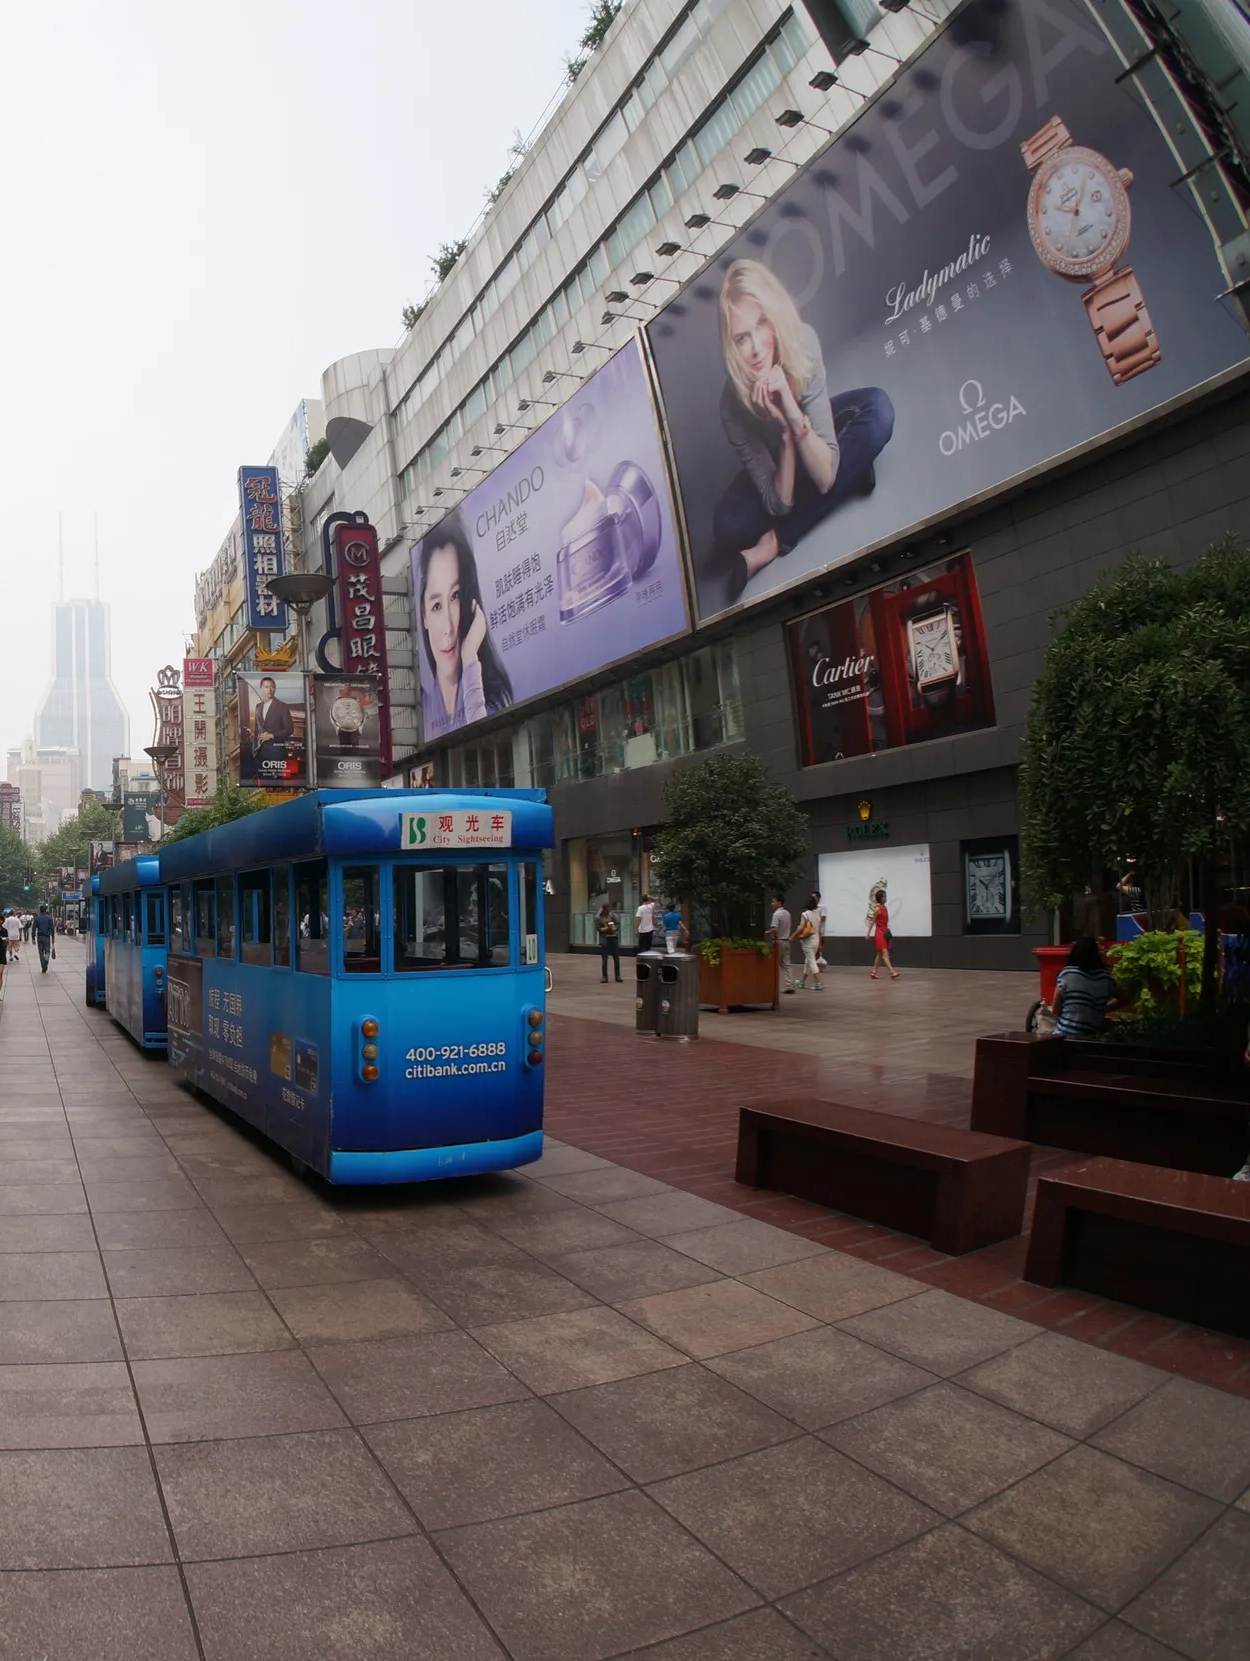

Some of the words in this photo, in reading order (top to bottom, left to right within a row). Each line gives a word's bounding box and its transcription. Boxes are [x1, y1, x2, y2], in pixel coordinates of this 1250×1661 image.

[762, 0, 1108, 310] OMEGA
[885, 233, 990, 325] Ladymatic
[939, 394, 1027, 456] OMEGA
[475, 465, 545, 538] CHANDO
[494, 552, 542, 599] 肌肤睡得饱
[489, 574, 554, 630] 鲜活饱满有光泽
[812, 655, 874, 687] Cartier
[262, 760, 288, 769] ORIS
[337, 761, 363, 770] ORIS
[439, 814, 504, 832] 观光车
[846, 822, 890, 838] ROLEX
[433, 836, 450, 845] City
[457, 834, 504, 843] Sightseeing
[405, 1042, 506, 1062] 400-921-6888
[405, 1061, 506, 1078] citibank.com.cn
